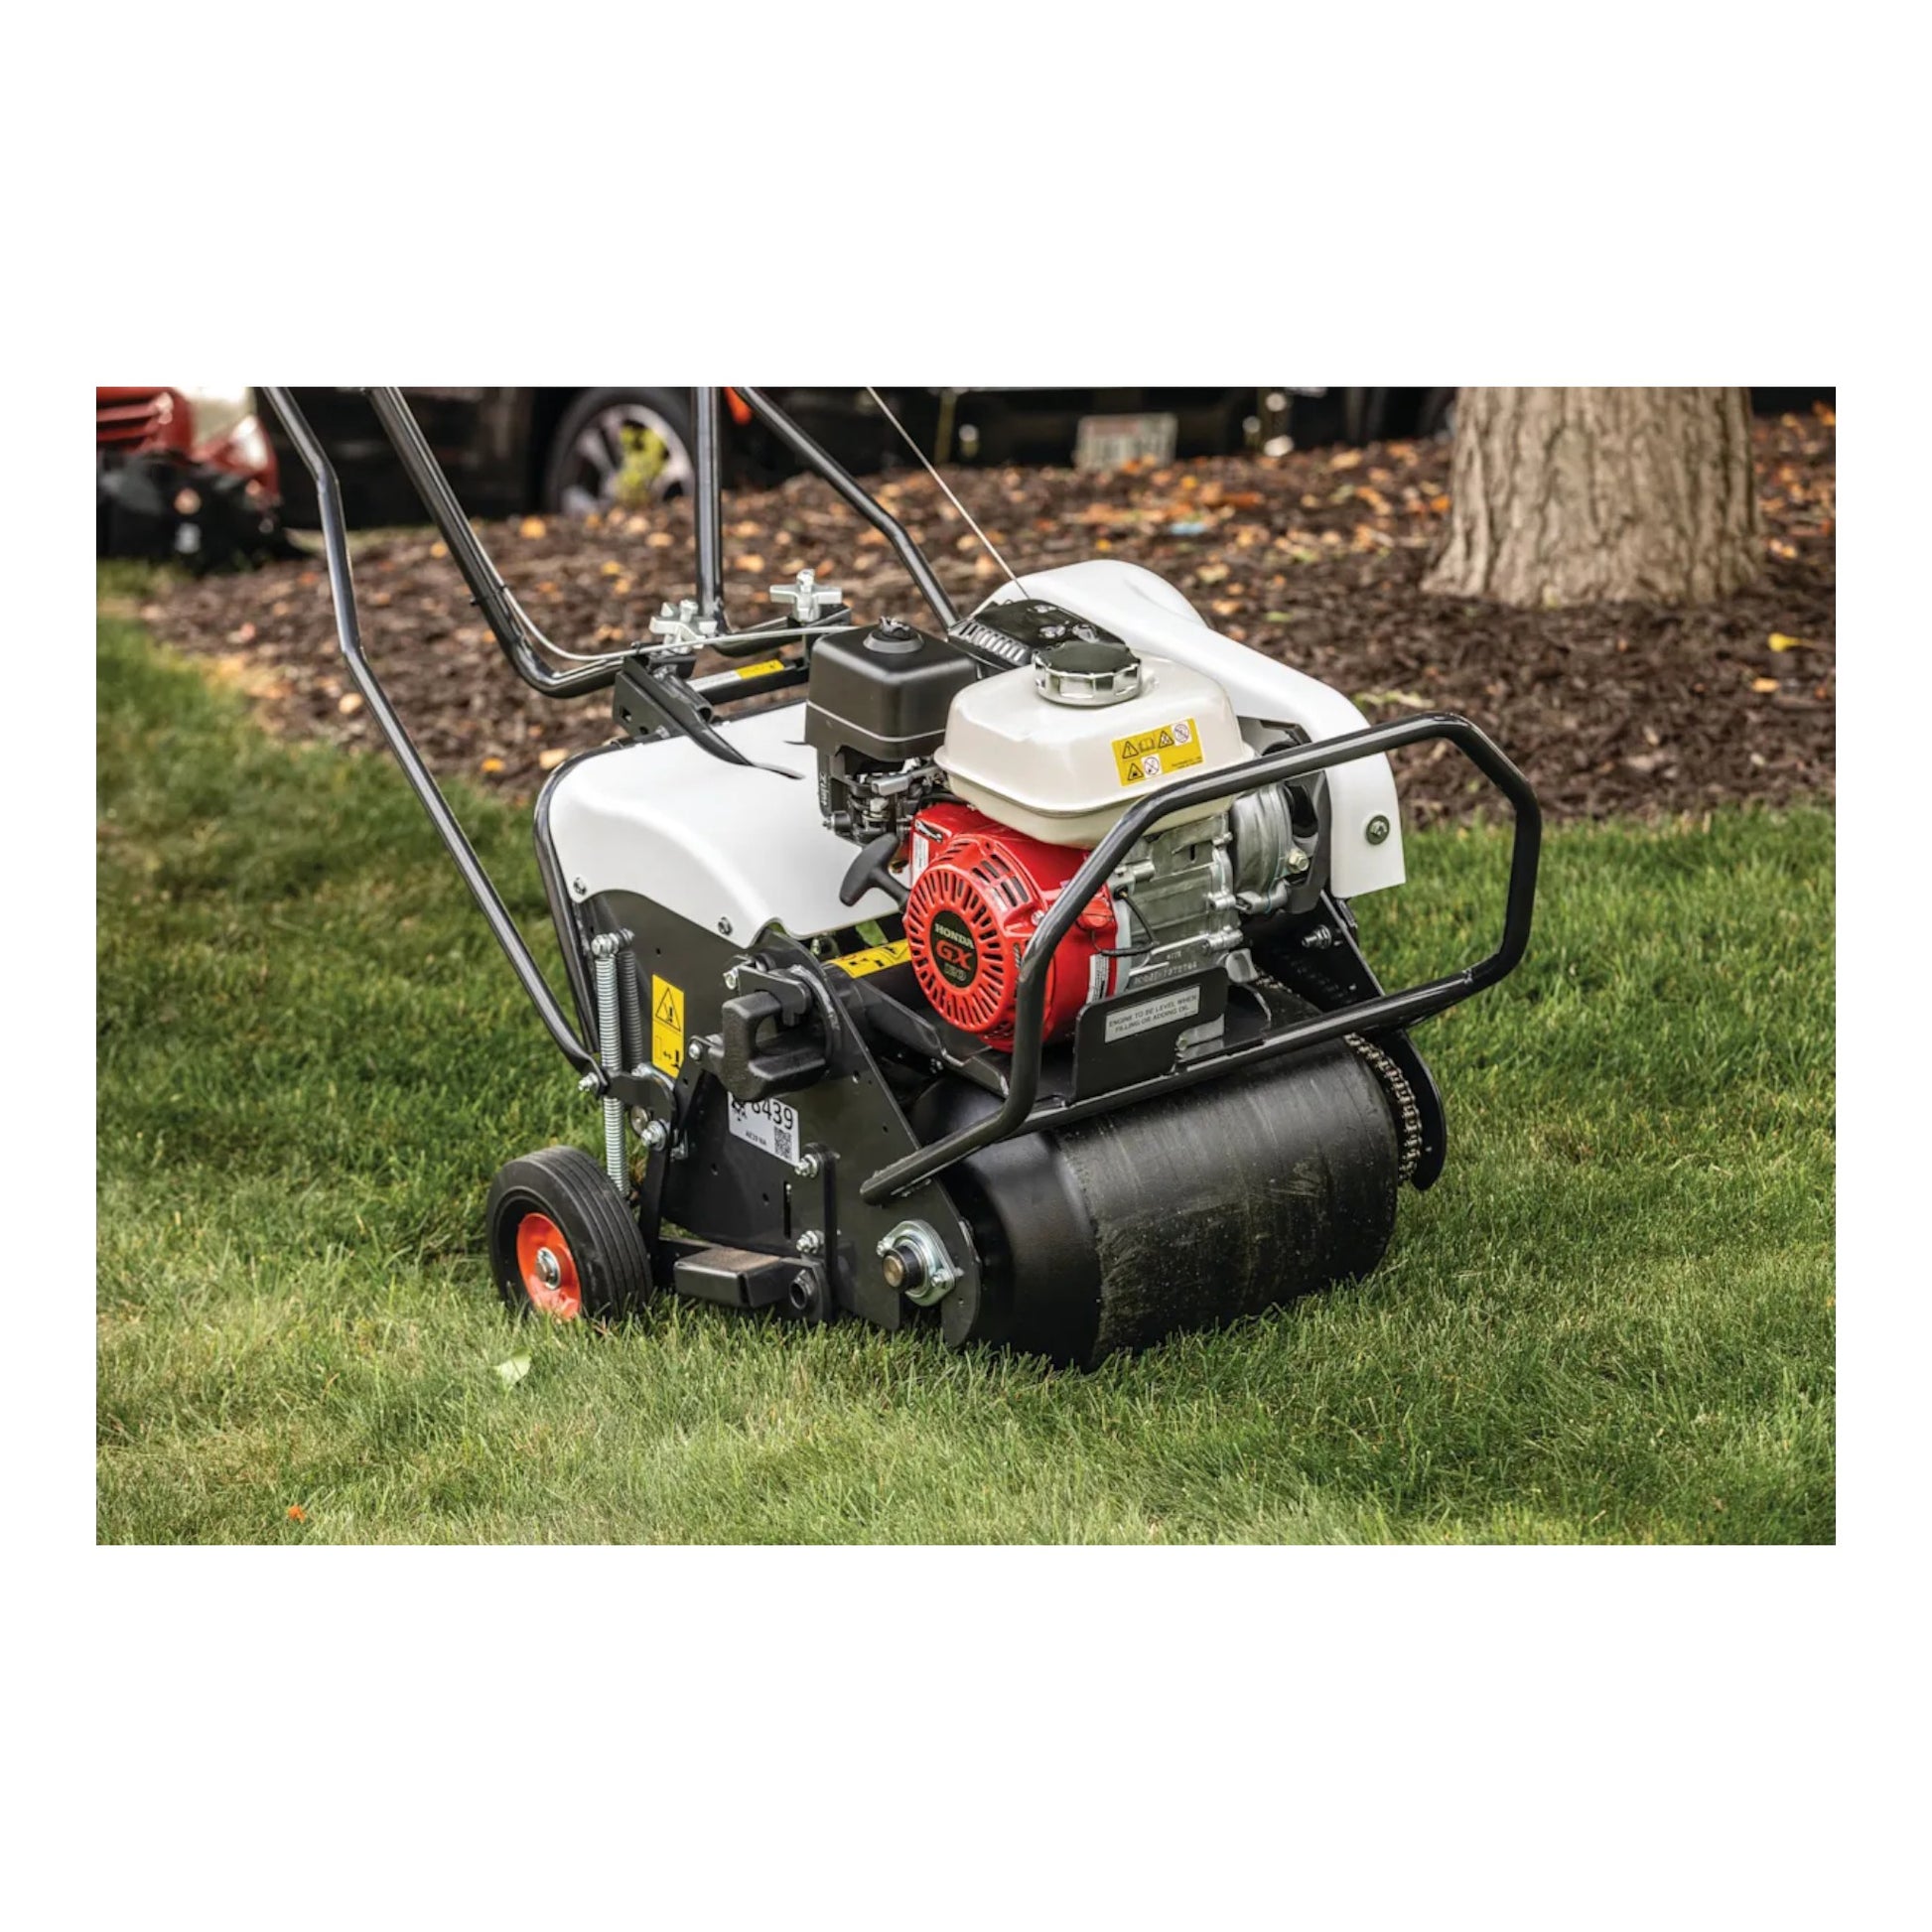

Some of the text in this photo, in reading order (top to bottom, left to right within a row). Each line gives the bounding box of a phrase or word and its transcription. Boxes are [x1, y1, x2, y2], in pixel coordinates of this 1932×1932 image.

[934, 922, 974, 949] HONDA
[937, 939, 972, 970] GX
[1109, 995, 1196, 1027] ENGINE TO BE LEVEL WHEN
[1115, 1020, 1141, 1032] FILLING
[1141, 1016, 1152, 1025] OR
[1154, 1010, 1177, 1021] ADDING
